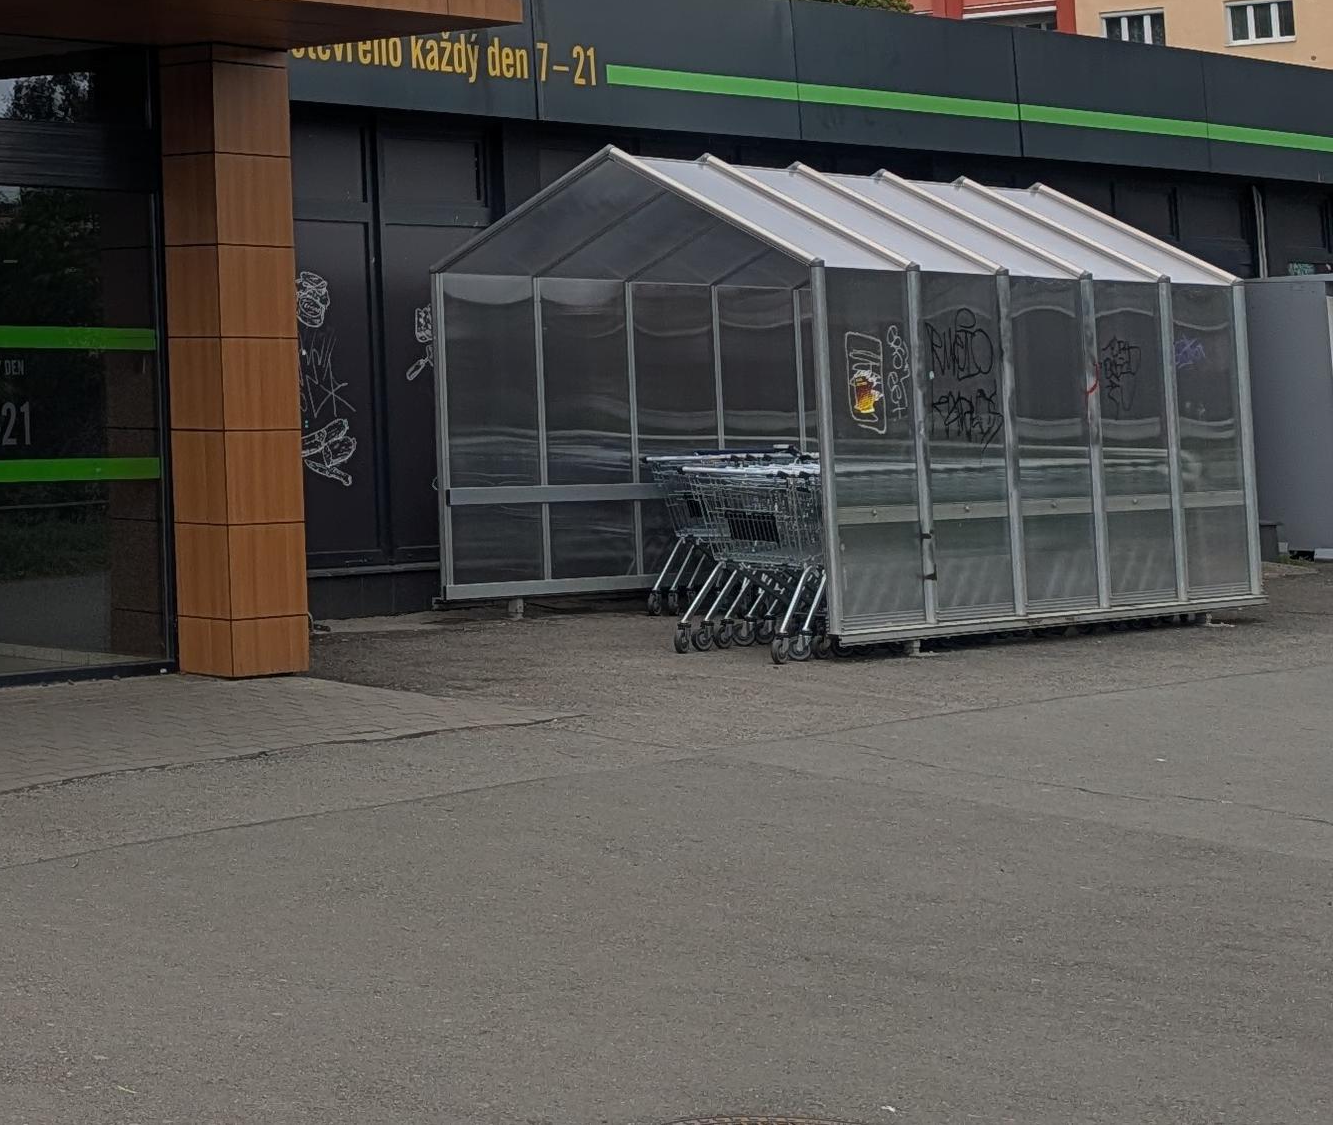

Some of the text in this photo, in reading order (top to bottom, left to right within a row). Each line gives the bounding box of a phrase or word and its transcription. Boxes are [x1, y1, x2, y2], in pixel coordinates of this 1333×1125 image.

[410, 31, 480, 84] každý
[487, 37, 530, 80] den
[5, 359, 24, 376] DEN
